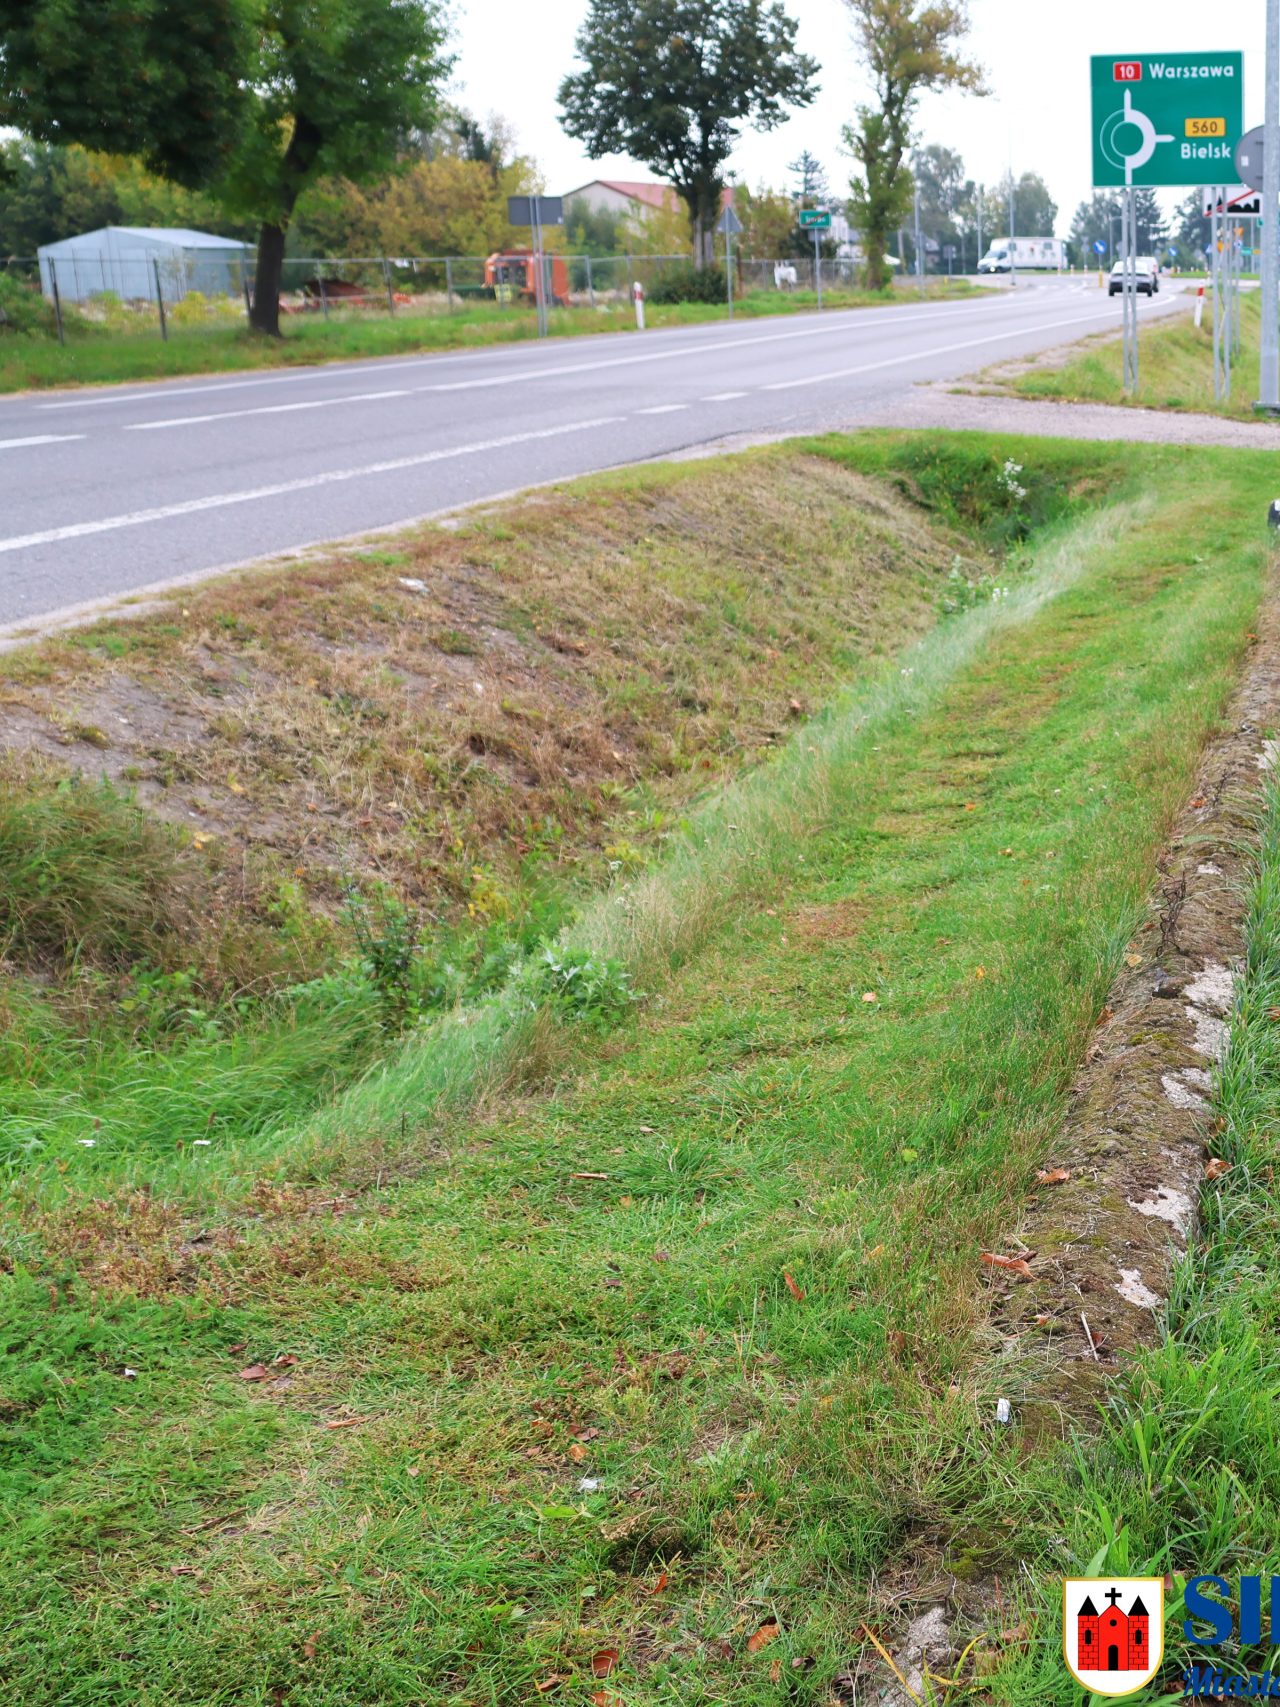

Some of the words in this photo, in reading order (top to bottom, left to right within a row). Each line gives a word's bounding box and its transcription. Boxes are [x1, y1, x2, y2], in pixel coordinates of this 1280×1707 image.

[1119, 65, 1135, 79] 10
[1149, 63, 1234, 79] Warszawa
[1192, 121, 1218, 134] 560
[1181, 143, 1231, 159] Bielsk
